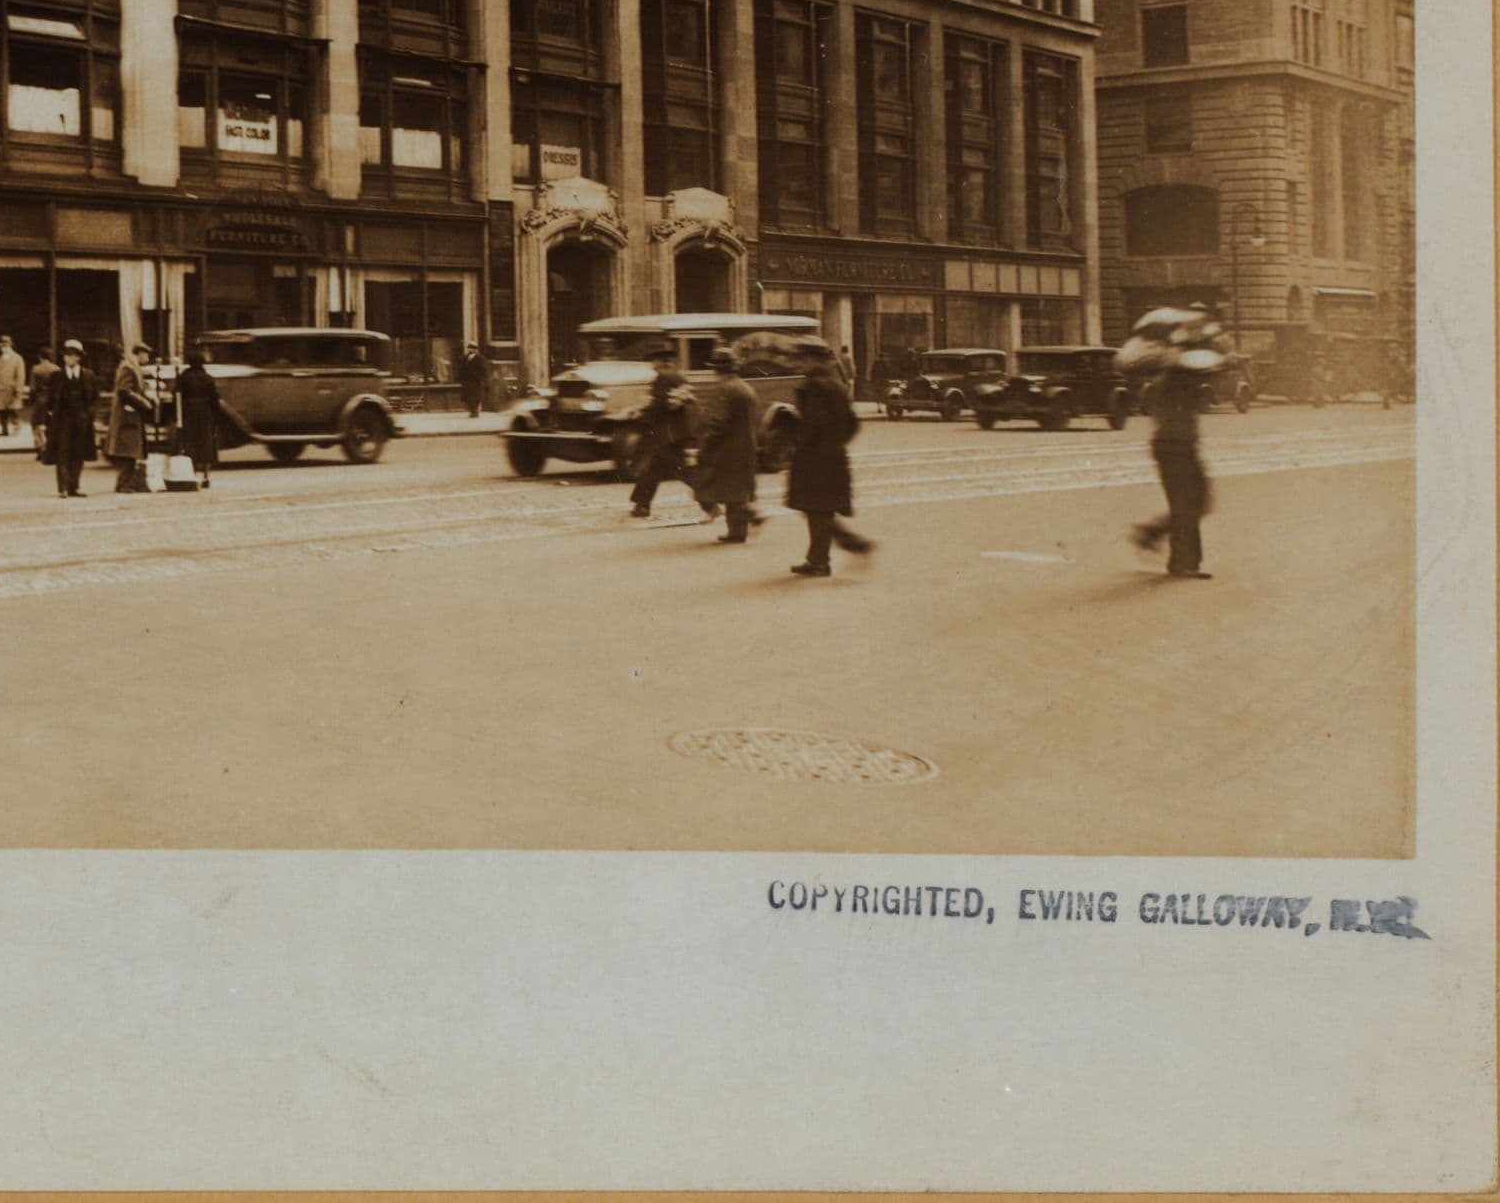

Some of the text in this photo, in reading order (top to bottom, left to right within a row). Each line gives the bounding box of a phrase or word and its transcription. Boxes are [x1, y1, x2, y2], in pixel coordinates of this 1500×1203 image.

[246, 127, 271, 142] COLOR
[222, 212, 298, 228] WHOLESALE
[211, 230, 286, 245] FURNITURE
